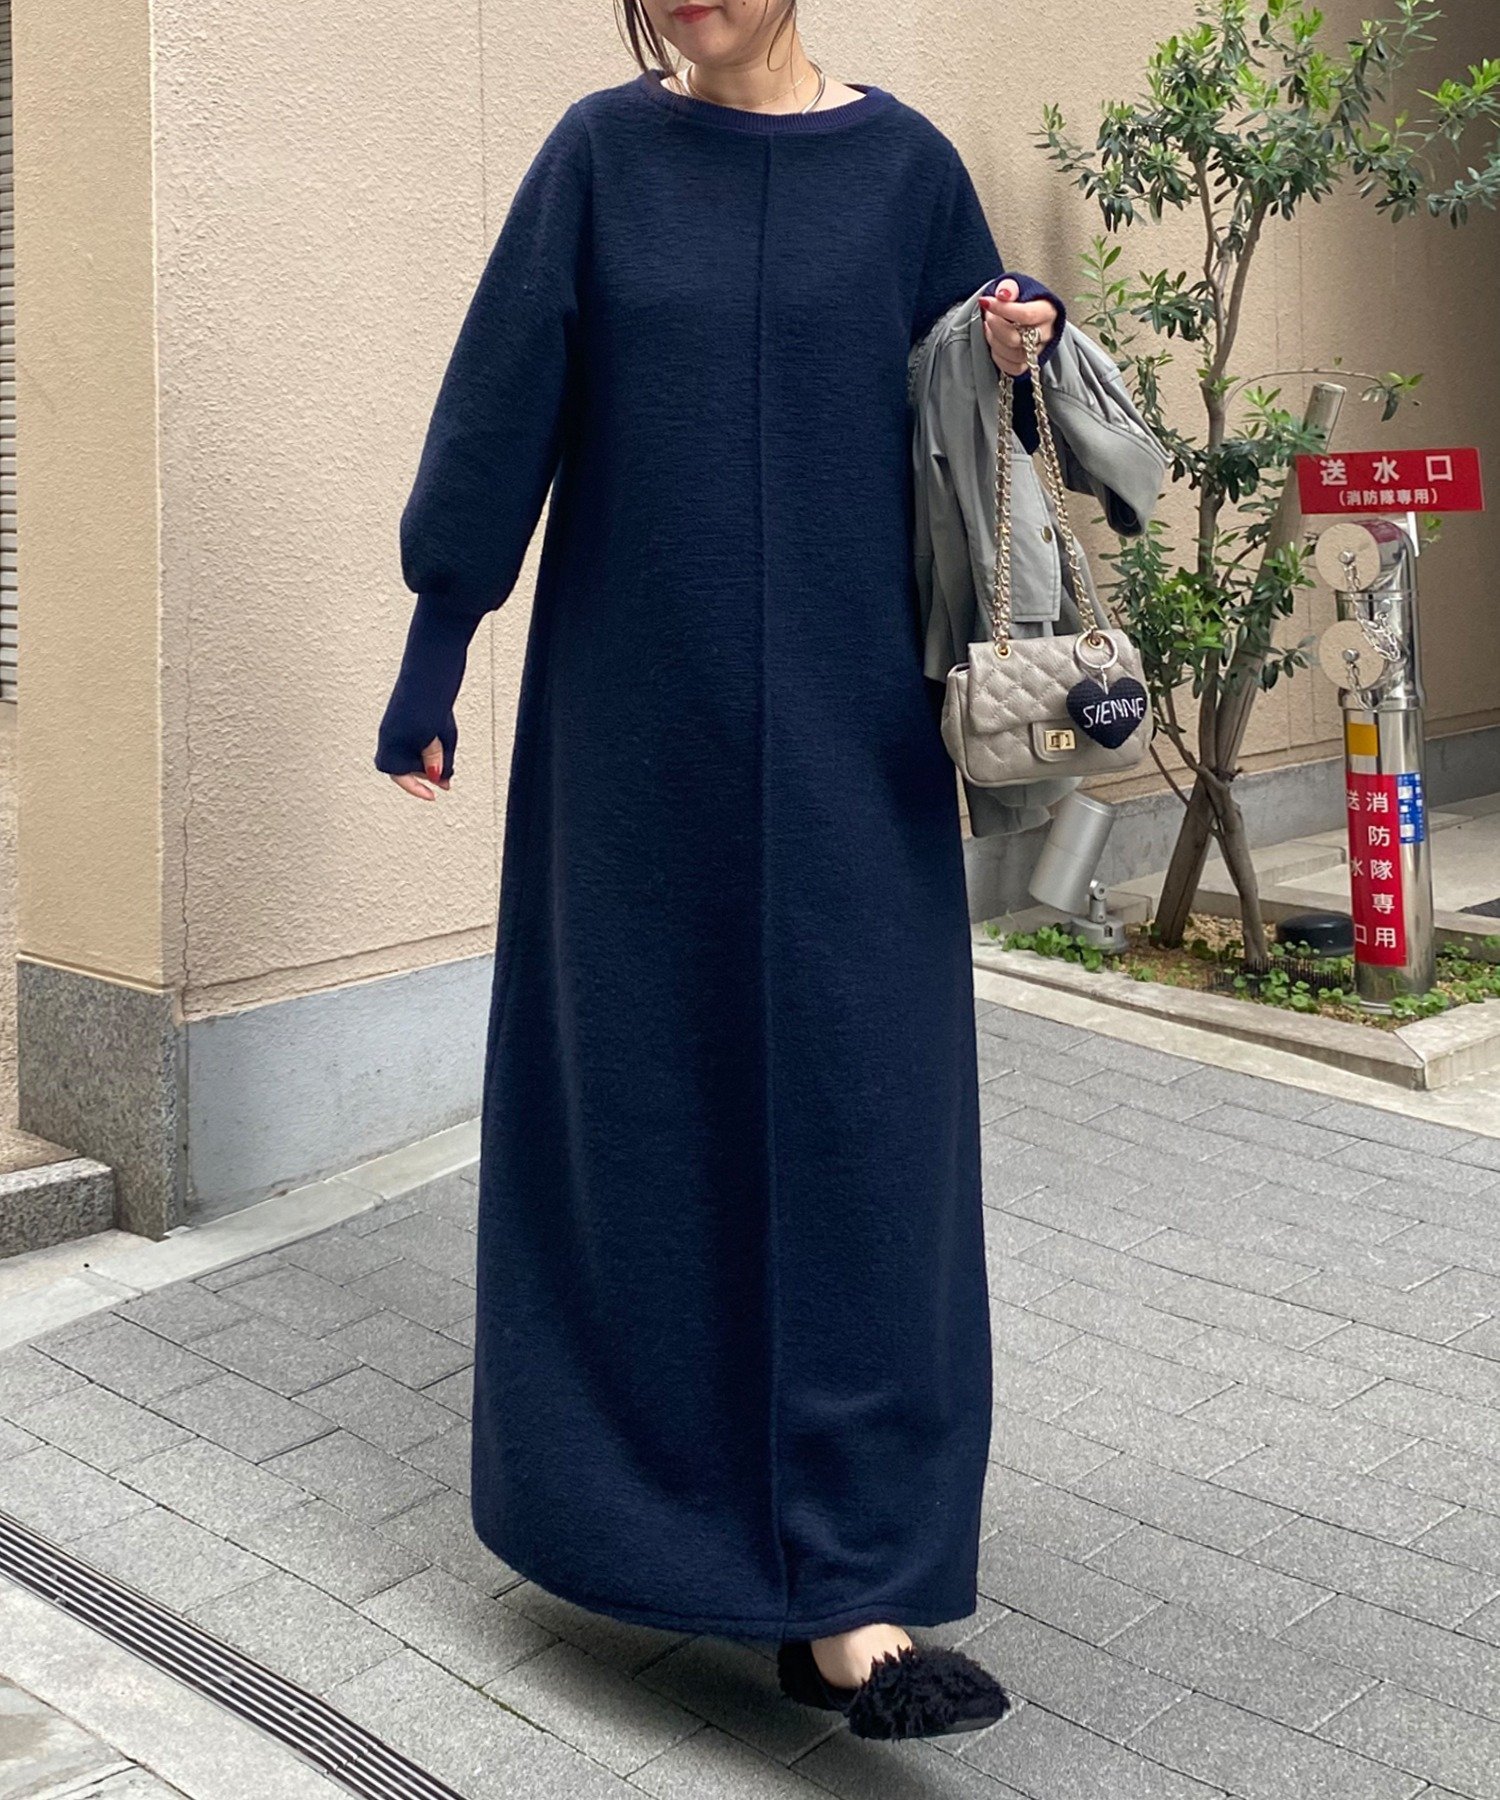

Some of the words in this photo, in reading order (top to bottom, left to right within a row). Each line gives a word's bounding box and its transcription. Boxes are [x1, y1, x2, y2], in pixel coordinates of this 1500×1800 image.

[1320, 455, 1453, 486] 送水口
[1083, 698, 1144, 728] SIENNE
[1366, 791, 1396, 948] 消防隊専用
